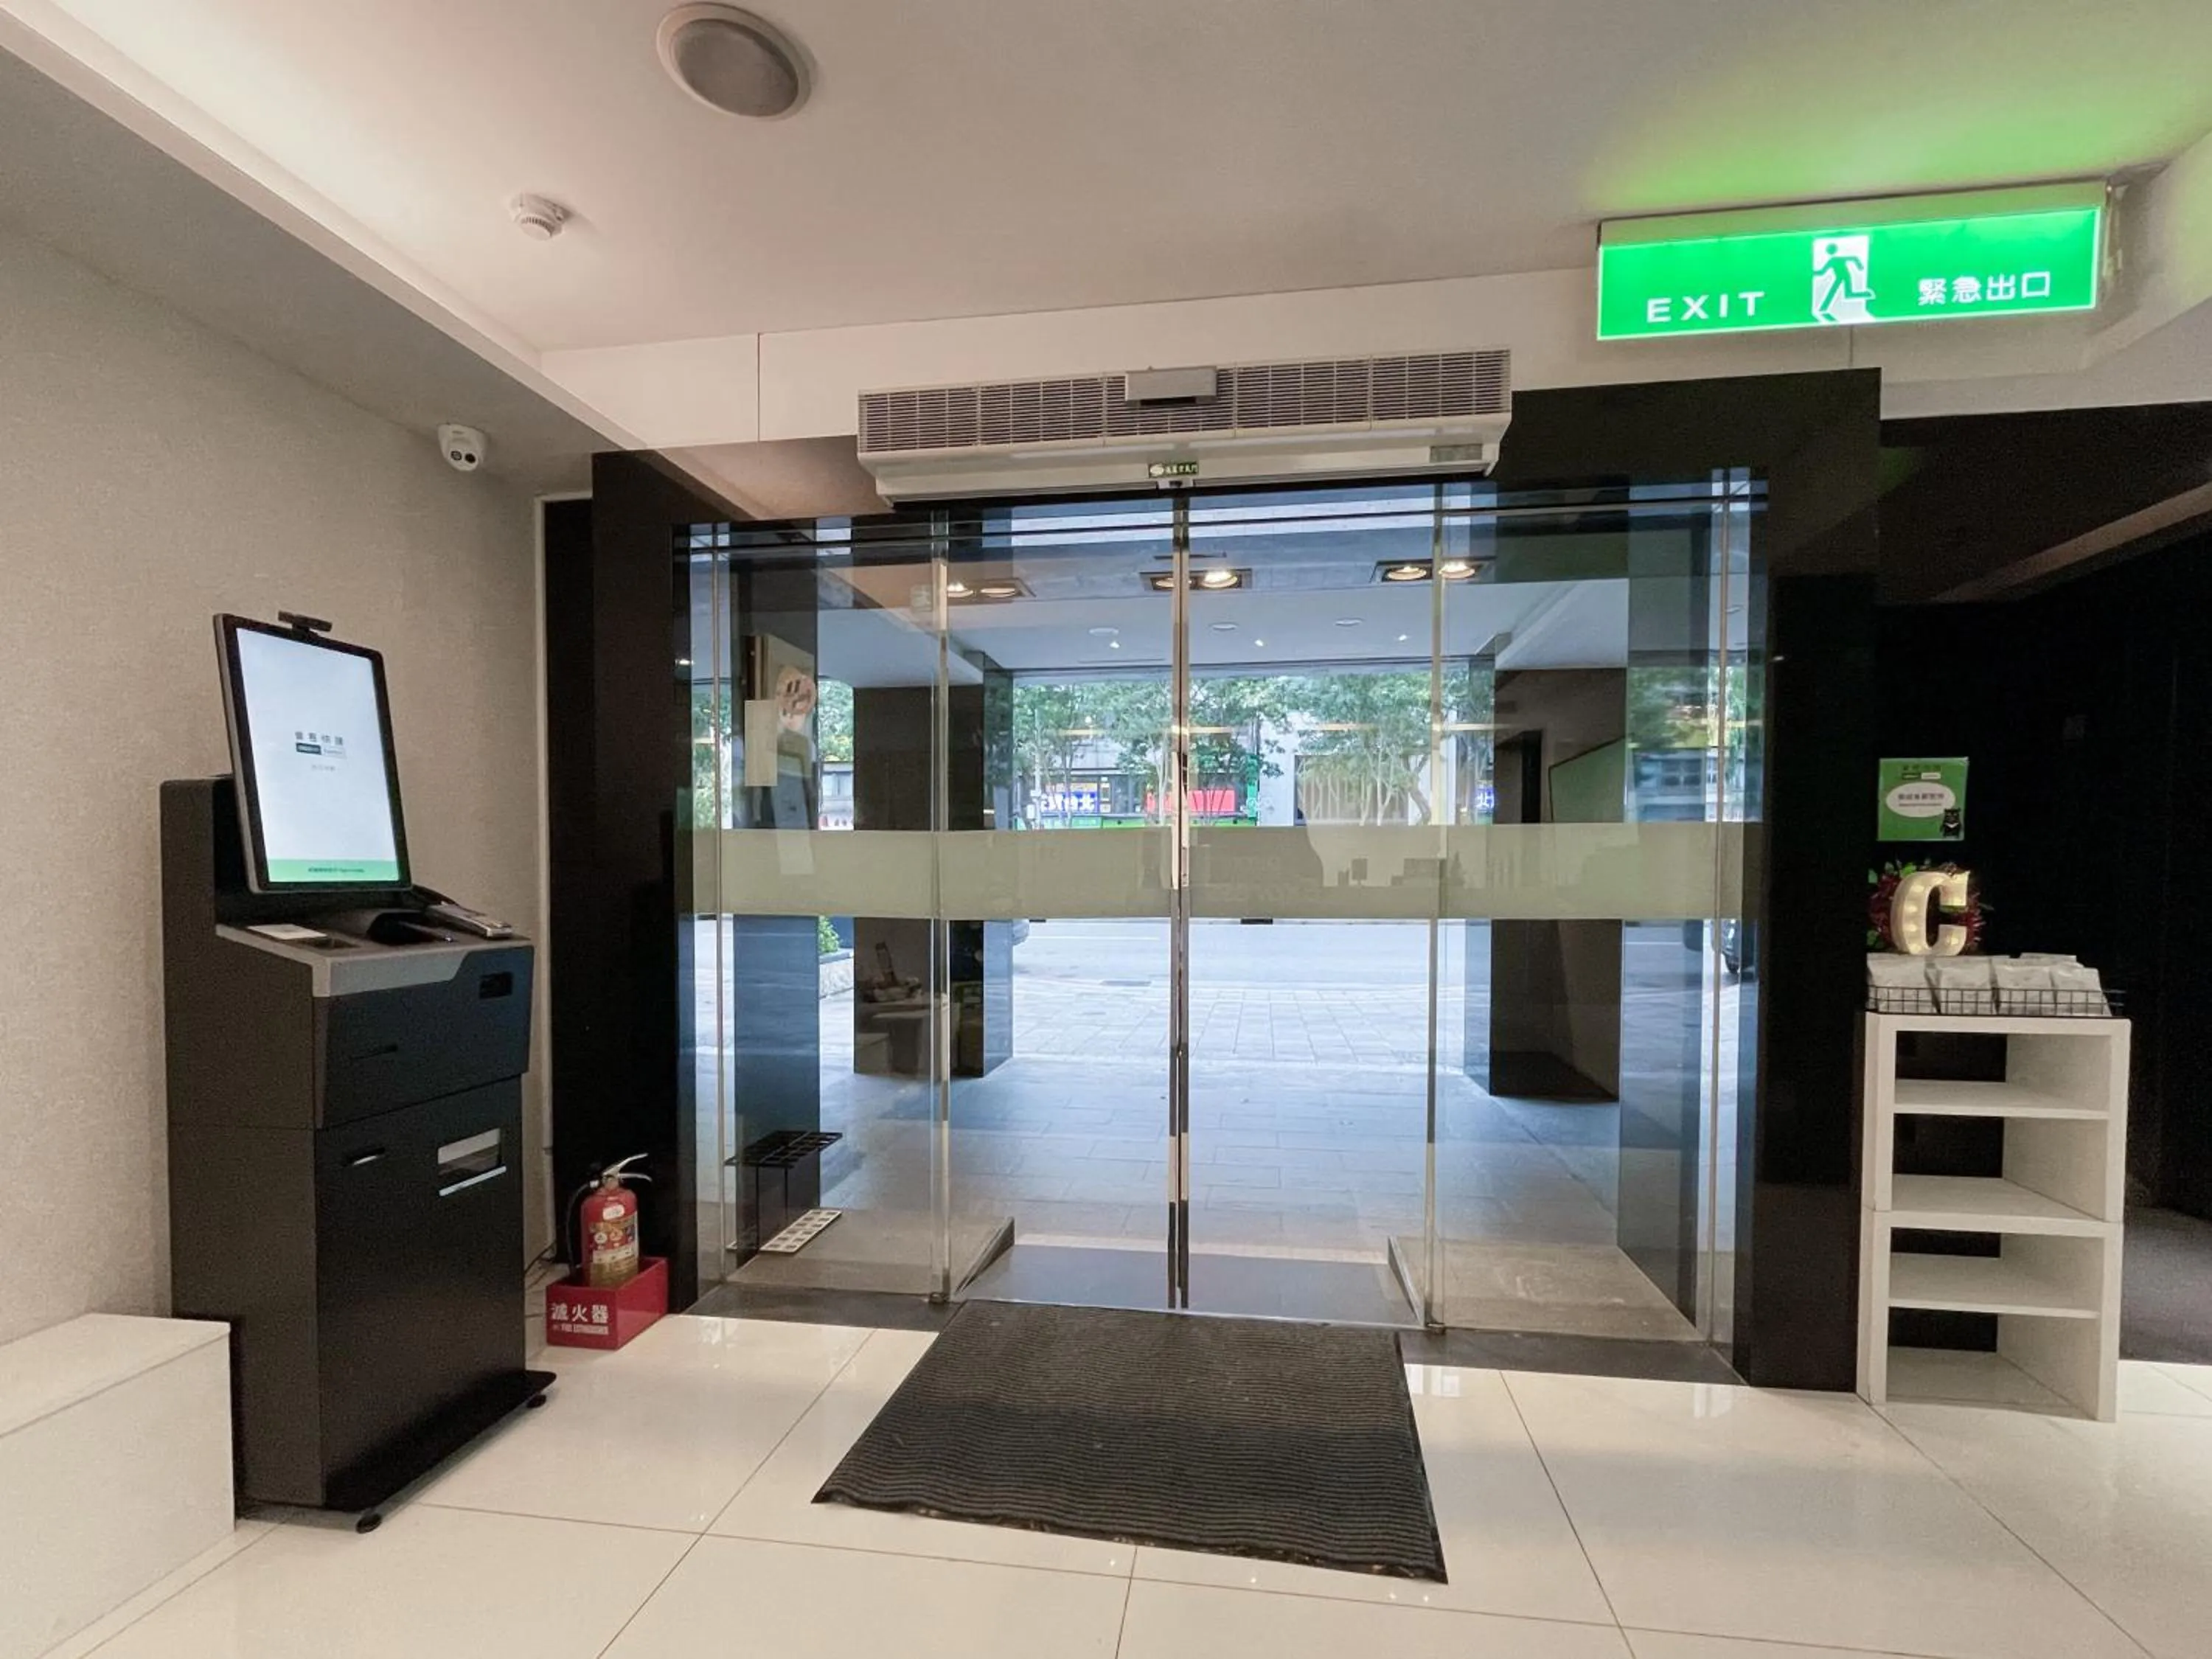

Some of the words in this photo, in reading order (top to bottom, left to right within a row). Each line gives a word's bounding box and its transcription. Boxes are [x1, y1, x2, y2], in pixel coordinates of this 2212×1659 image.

[1917, 271, 2052, 307] 緊急出口
[1646, 292, 1765, 323] EXIT
[1891, 871, 1969, 956] C
